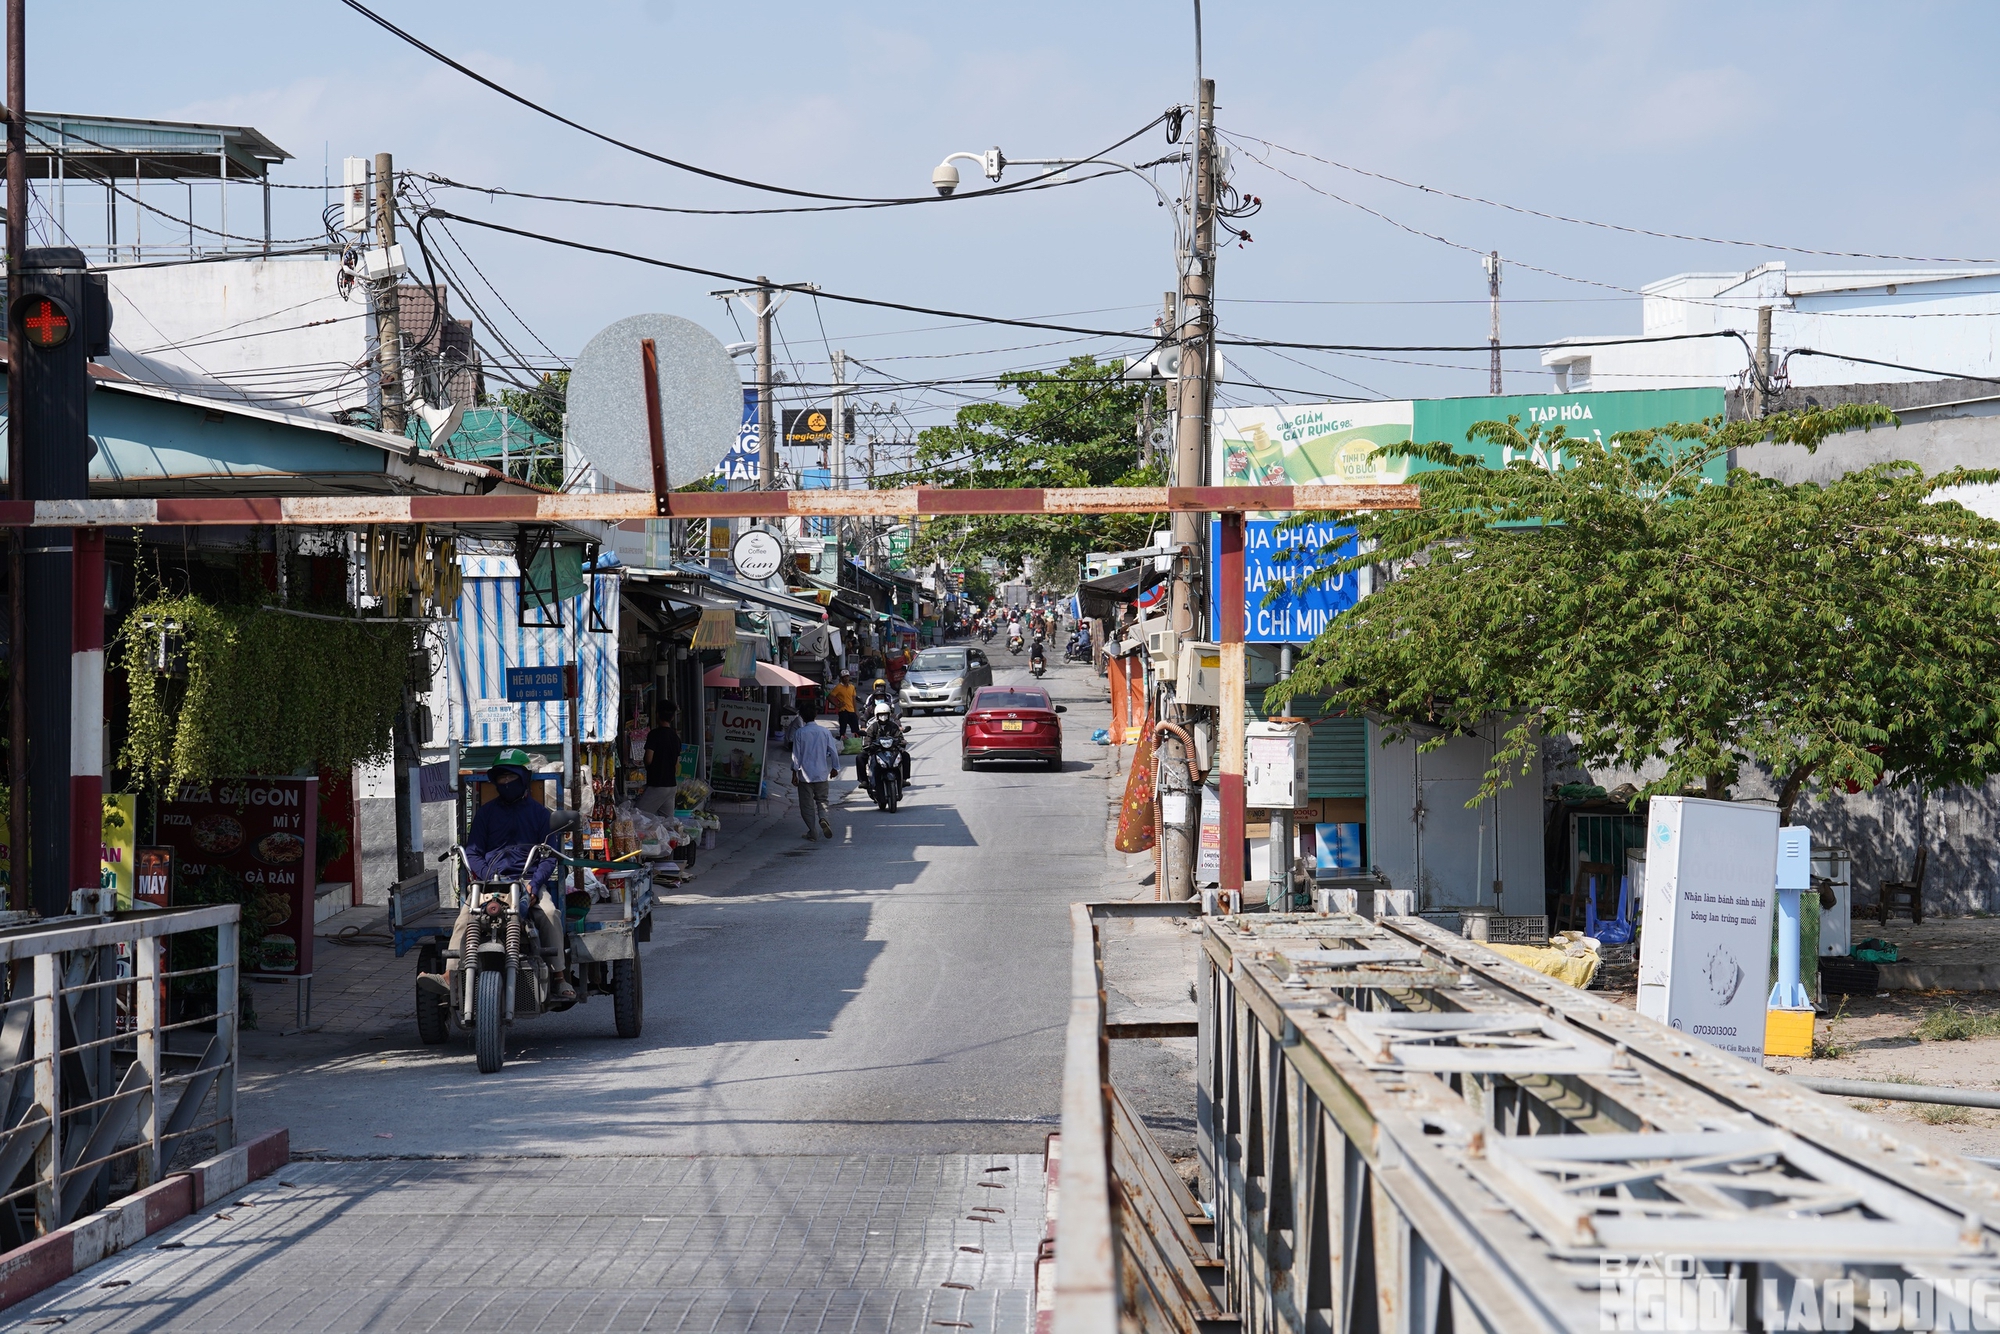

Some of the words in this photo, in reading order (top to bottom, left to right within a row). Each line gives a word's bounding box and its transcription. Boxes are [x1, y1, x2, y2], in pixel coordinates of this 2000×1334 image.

[1294, 411, 1323, 426] GIẢM
[1529, 406, 1558, 424] TẠP
[1561, 402, 1593, 420] HÓA
[1308, 420, 1339, 437] RỤNG
[1277, 524, 1334, 553] PHẬN
[1257, 602, 1292, 636] CHÍ
[535, 673, 558, 685] 2066
[722, 710, 762, 731] Lam
[219, 787, 298, 807] SAIGON
[163, 814, 193, 826] PIZZA
[273, 813, 289, 827] MÌ
[292, 813, 300, 828] Ý
[182, 863, 206, 875] CAY
[245, 868, 264, 883] GÀ
[268, 869, 295, 884] RÁN
[138, 872, 168, 895] MÁY
[1684, 891, 1702, 904] Nhận
[1703, 893, 1717, 903] làm
[1718, 894, 1734, 905] bánh
[1736, 895, 1750, 906] sinh
[1751, 897, 1766, 909] nhật
[1690, 910, 1707, 923] bông
[1709, 912, 1719, 922] lan
[1721, 913, 1739, 926] trứng
[1740, 915, 1757, 925] muối
[1692, 1024, 1738, 1037] 0703013002
